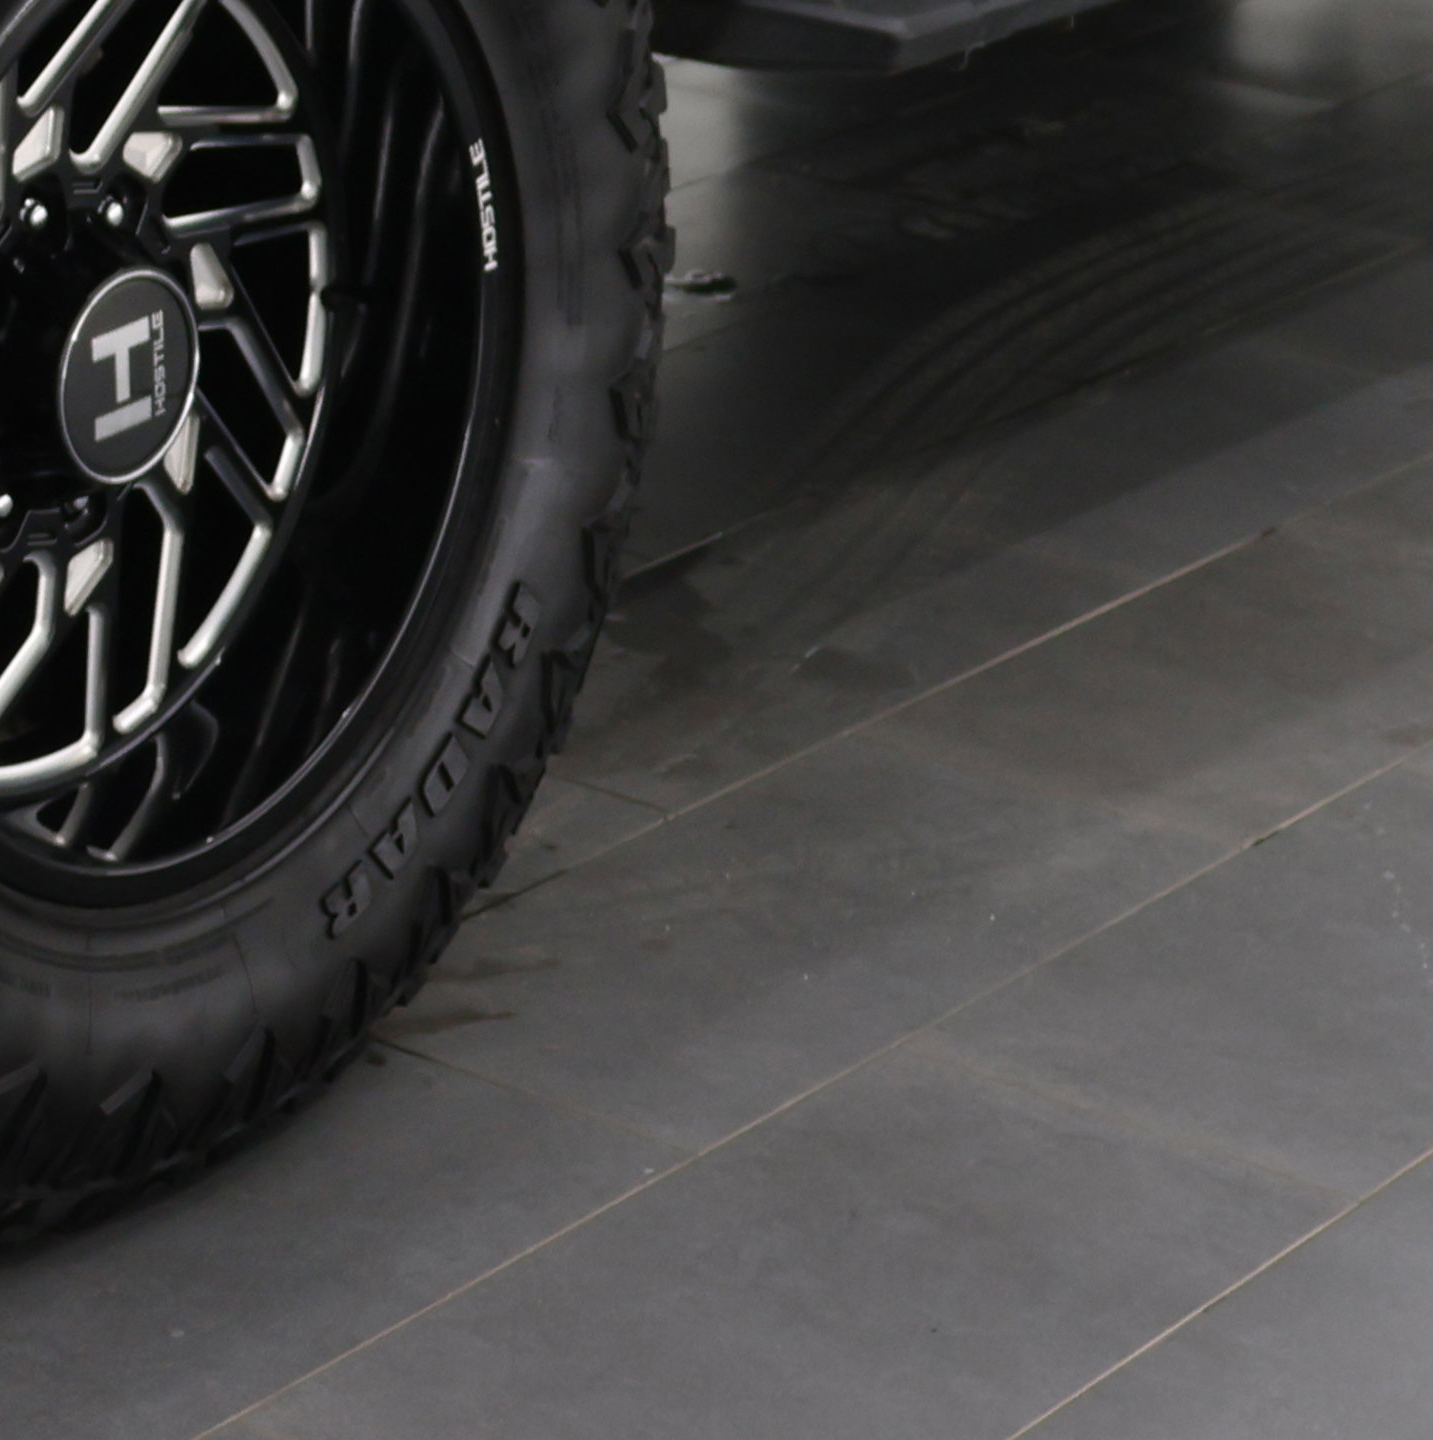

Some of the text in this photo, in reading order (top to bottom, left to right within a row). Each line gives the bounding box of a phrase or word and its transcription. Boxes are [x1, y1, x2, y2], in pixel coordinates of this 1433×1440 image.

[468, 136, 500, 274] HOSTILE
[150, 308, 167, 418] HOSTILE
[318, 580, 542, 941] RADAR
